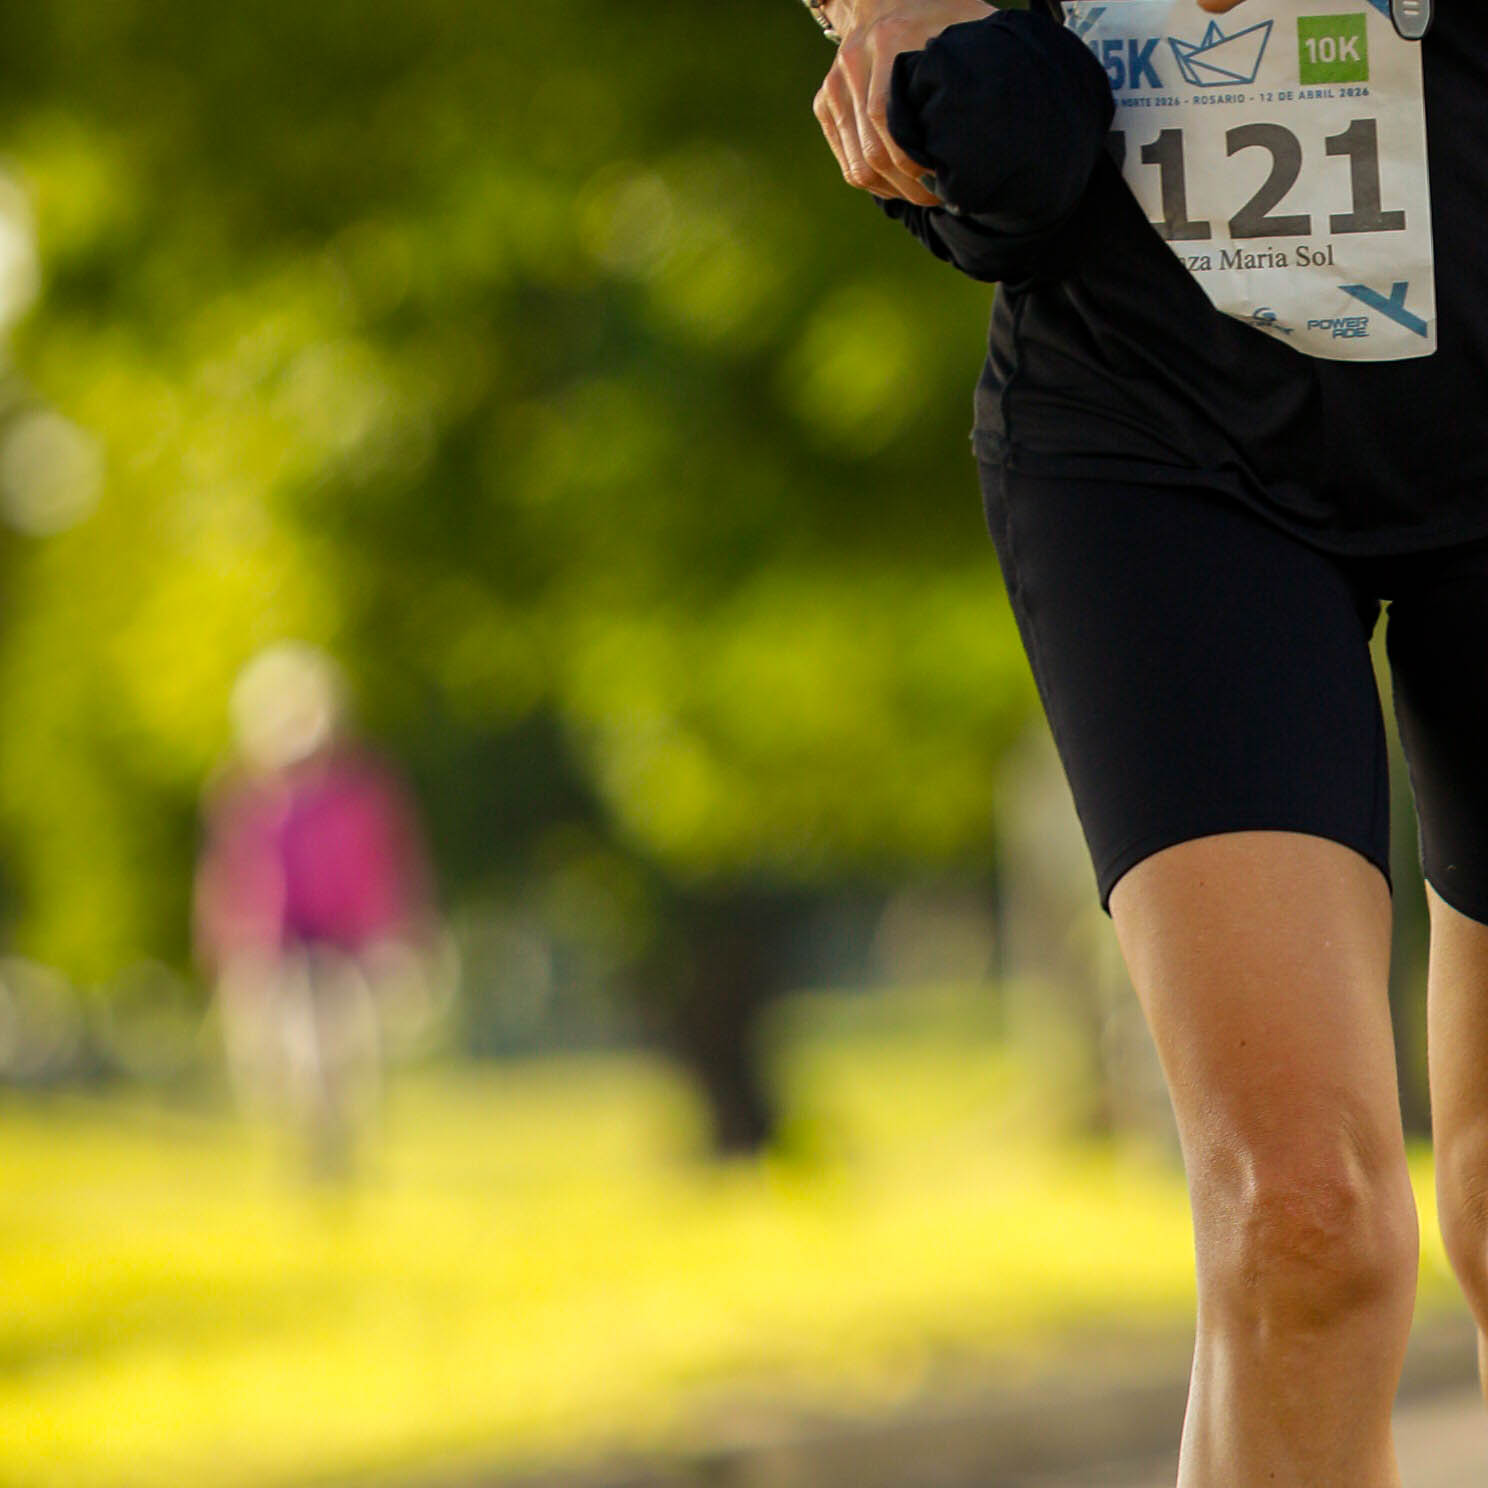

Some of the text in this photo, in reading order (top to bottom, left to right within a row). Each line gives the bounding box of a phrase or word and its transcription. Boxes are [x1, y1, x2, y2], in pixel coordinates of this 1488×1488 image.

[1305, 36, 1361, 63] 10K
[1089, 38, 1164, 89] 5K
[1193, 94, 1245, 105] ROSARIO
[1260, 92, 1273, 102] 12
[1279, 91, 1294, 101] DE
[1299, 88, 1335, 100] ABRIL
[1340, 87, 1370, 98] 2026
[1106, 118, 1406, 241] 121
[1219, 247, 1289, 271] Maria
[1295, 244, 1335, 267] Sol
[1307, 316, 1369, 331] POWER
